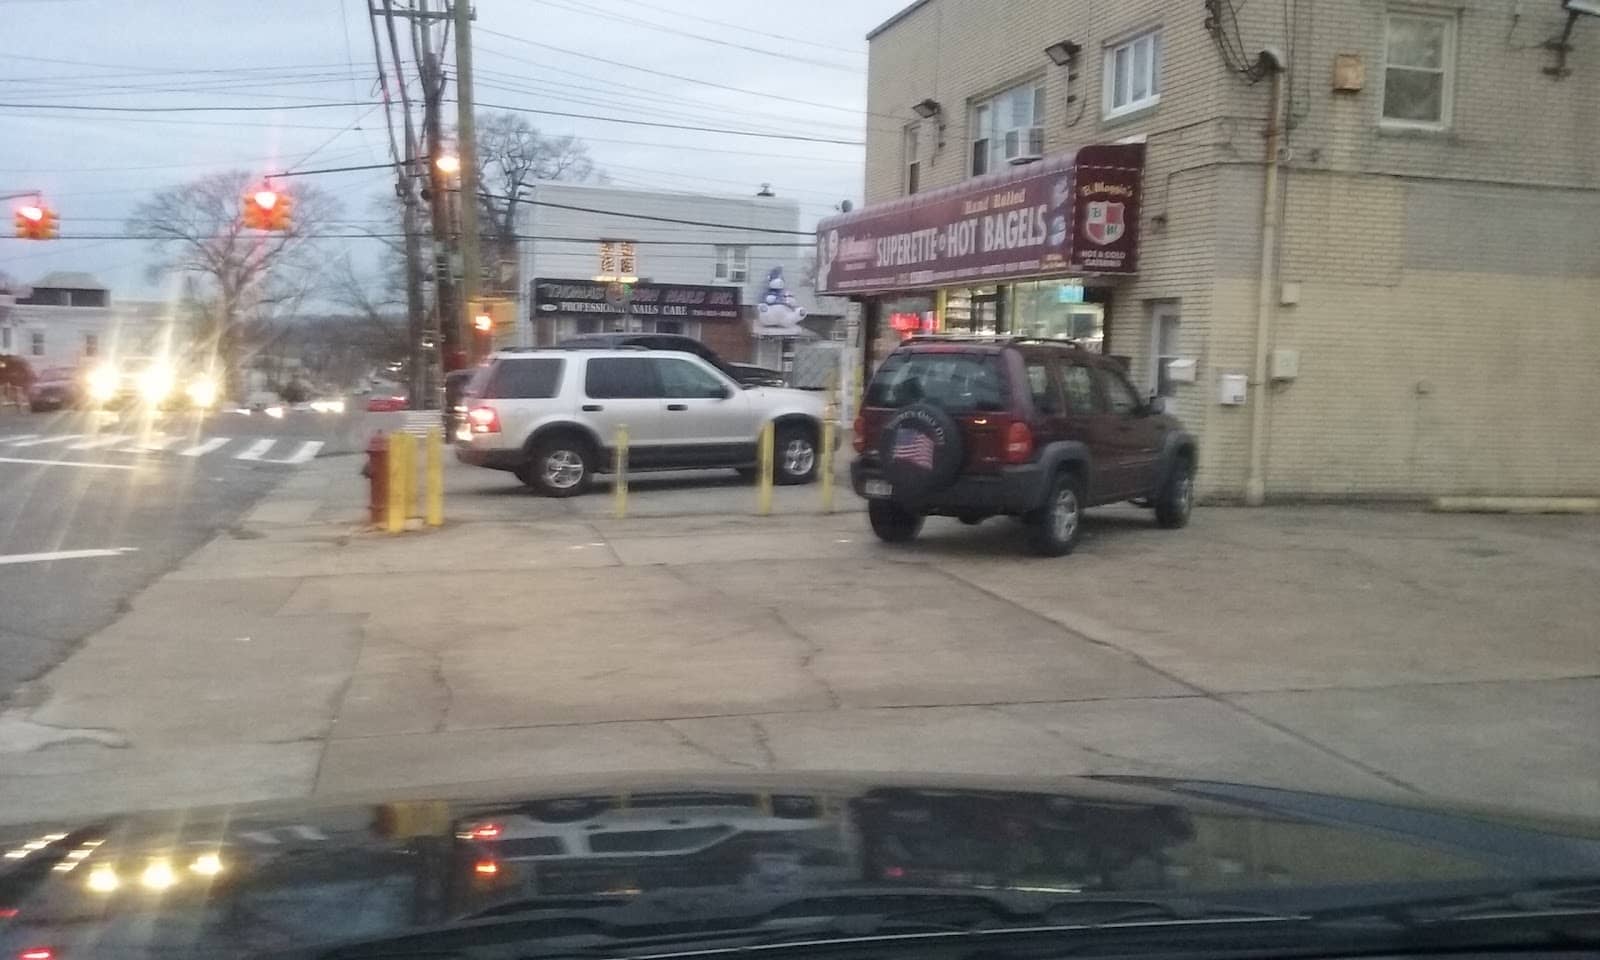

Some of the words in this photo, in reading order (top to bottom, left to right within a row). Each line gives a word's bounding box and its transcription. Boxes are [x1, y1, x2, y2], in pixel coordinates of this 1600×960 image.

[964, 196, 989, 216] Hand
[993, 187, 1026, 209] Rolled
[876, 226, 938, 268] SUPERETTE
[947, 217, 978, 258] HOT
[983, 203, 1048, 253] BAGELS
[1081, 250, 1097, 259] HOT
[1104, 251, 1126, 260] COLD
[632, 304, 659, 315] NAILS
[663, 305, 688, 316] CARE
